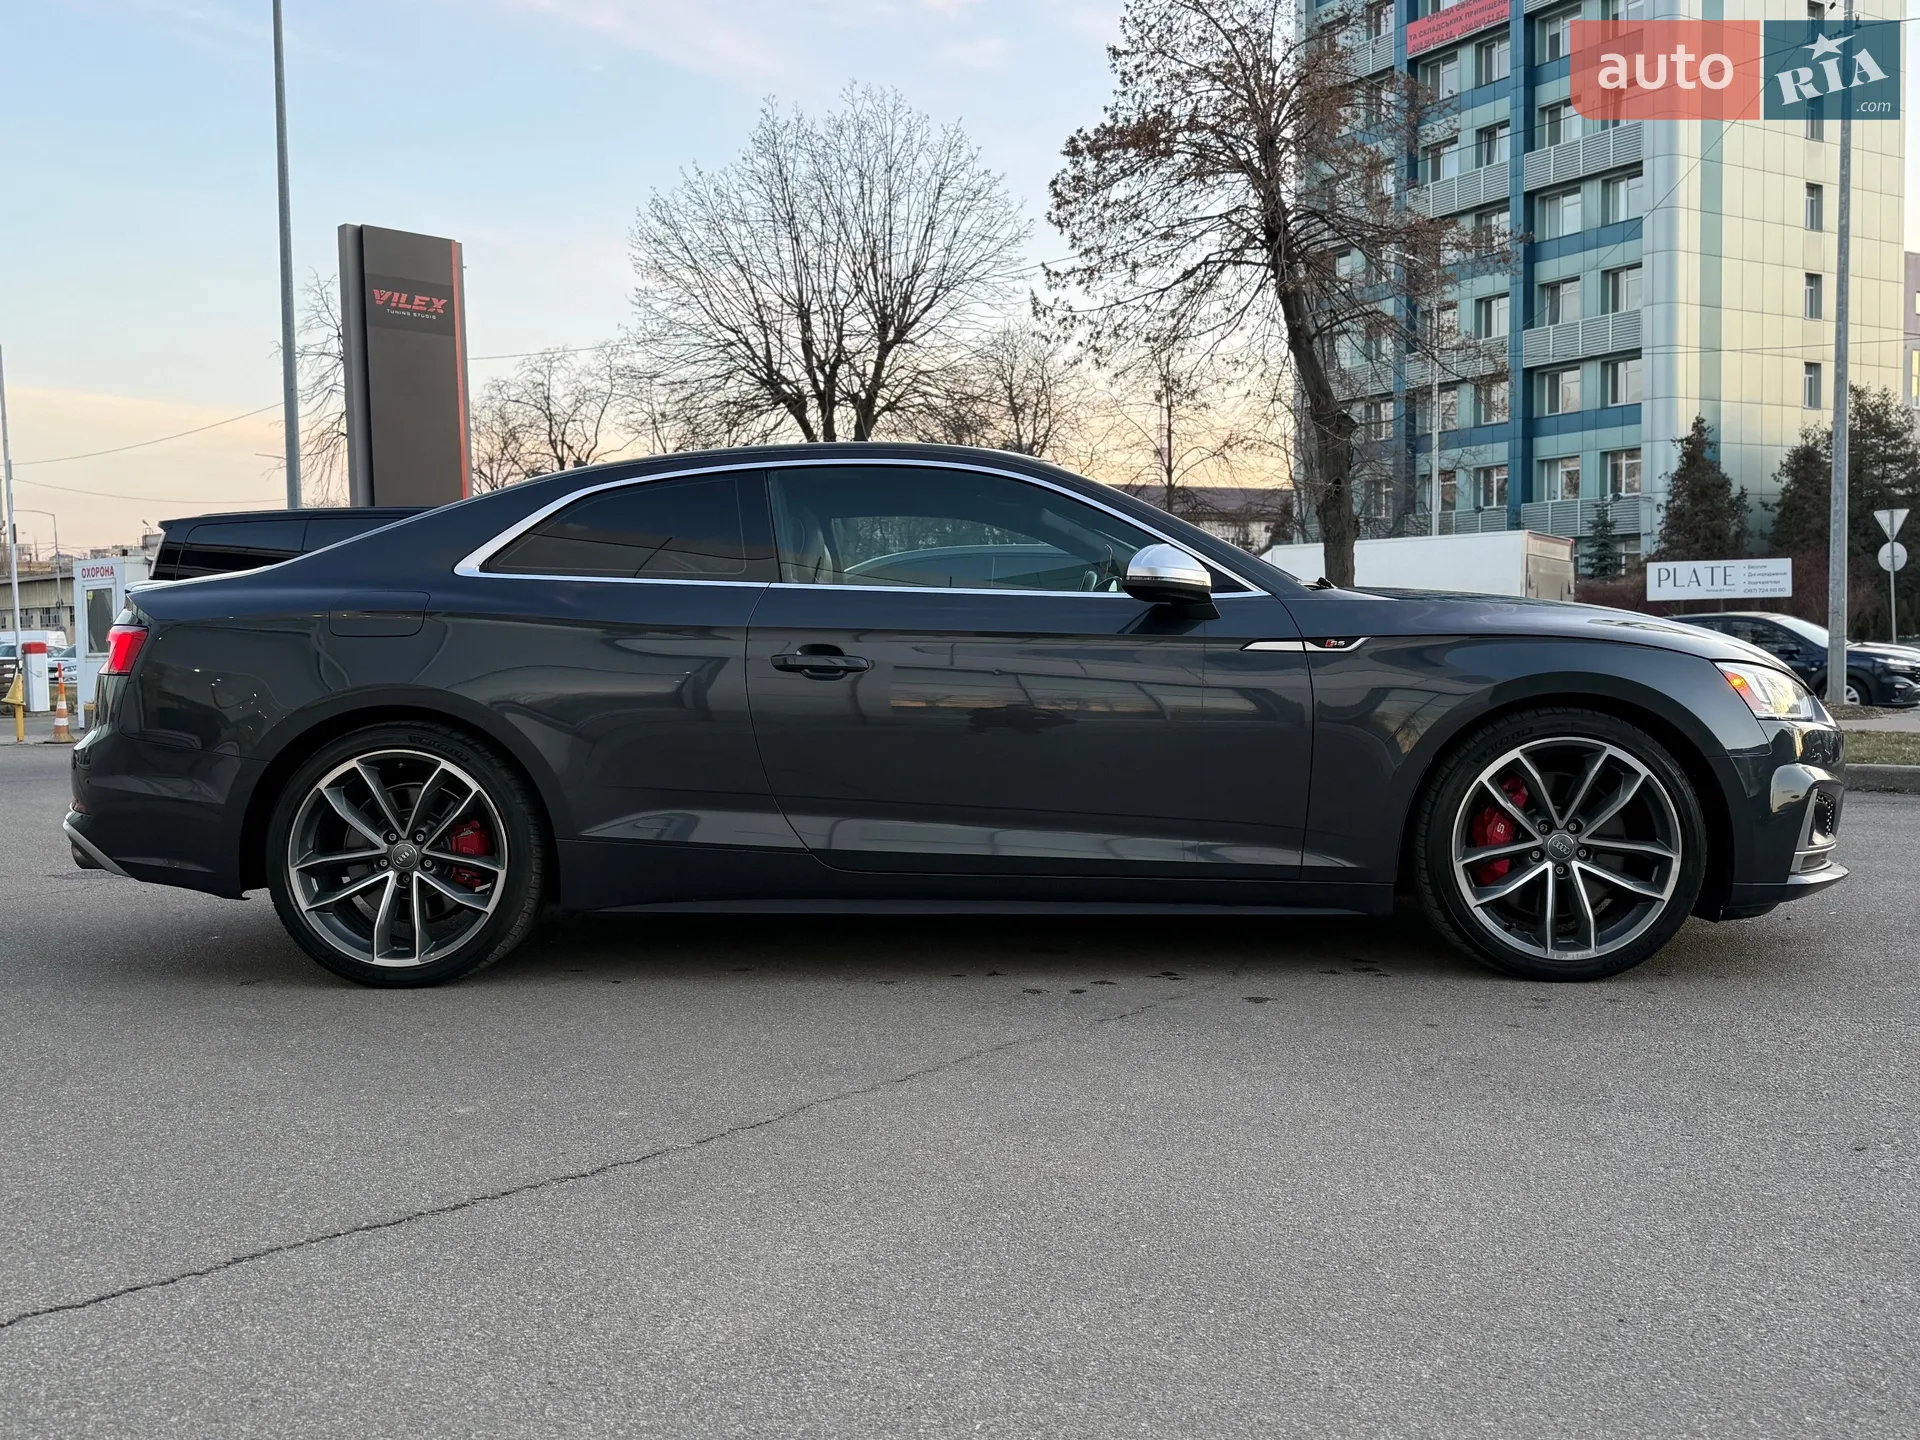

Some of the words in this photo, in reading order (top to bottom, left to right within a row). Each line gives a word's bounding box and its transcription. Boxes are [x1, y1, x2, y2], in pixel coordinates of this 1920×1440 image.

[1427, 8, 1454, 23] ОРЕНДА
[1419, 16, 1463, 37] СКЛАДСЬКИХ
[373, 289, 448, 314] VILEX
[387, 308, 411, 316] TUNING
[81, 566, 115, 579] ОХОРОНА
[1657, 566, 1736, 588] PLATE
